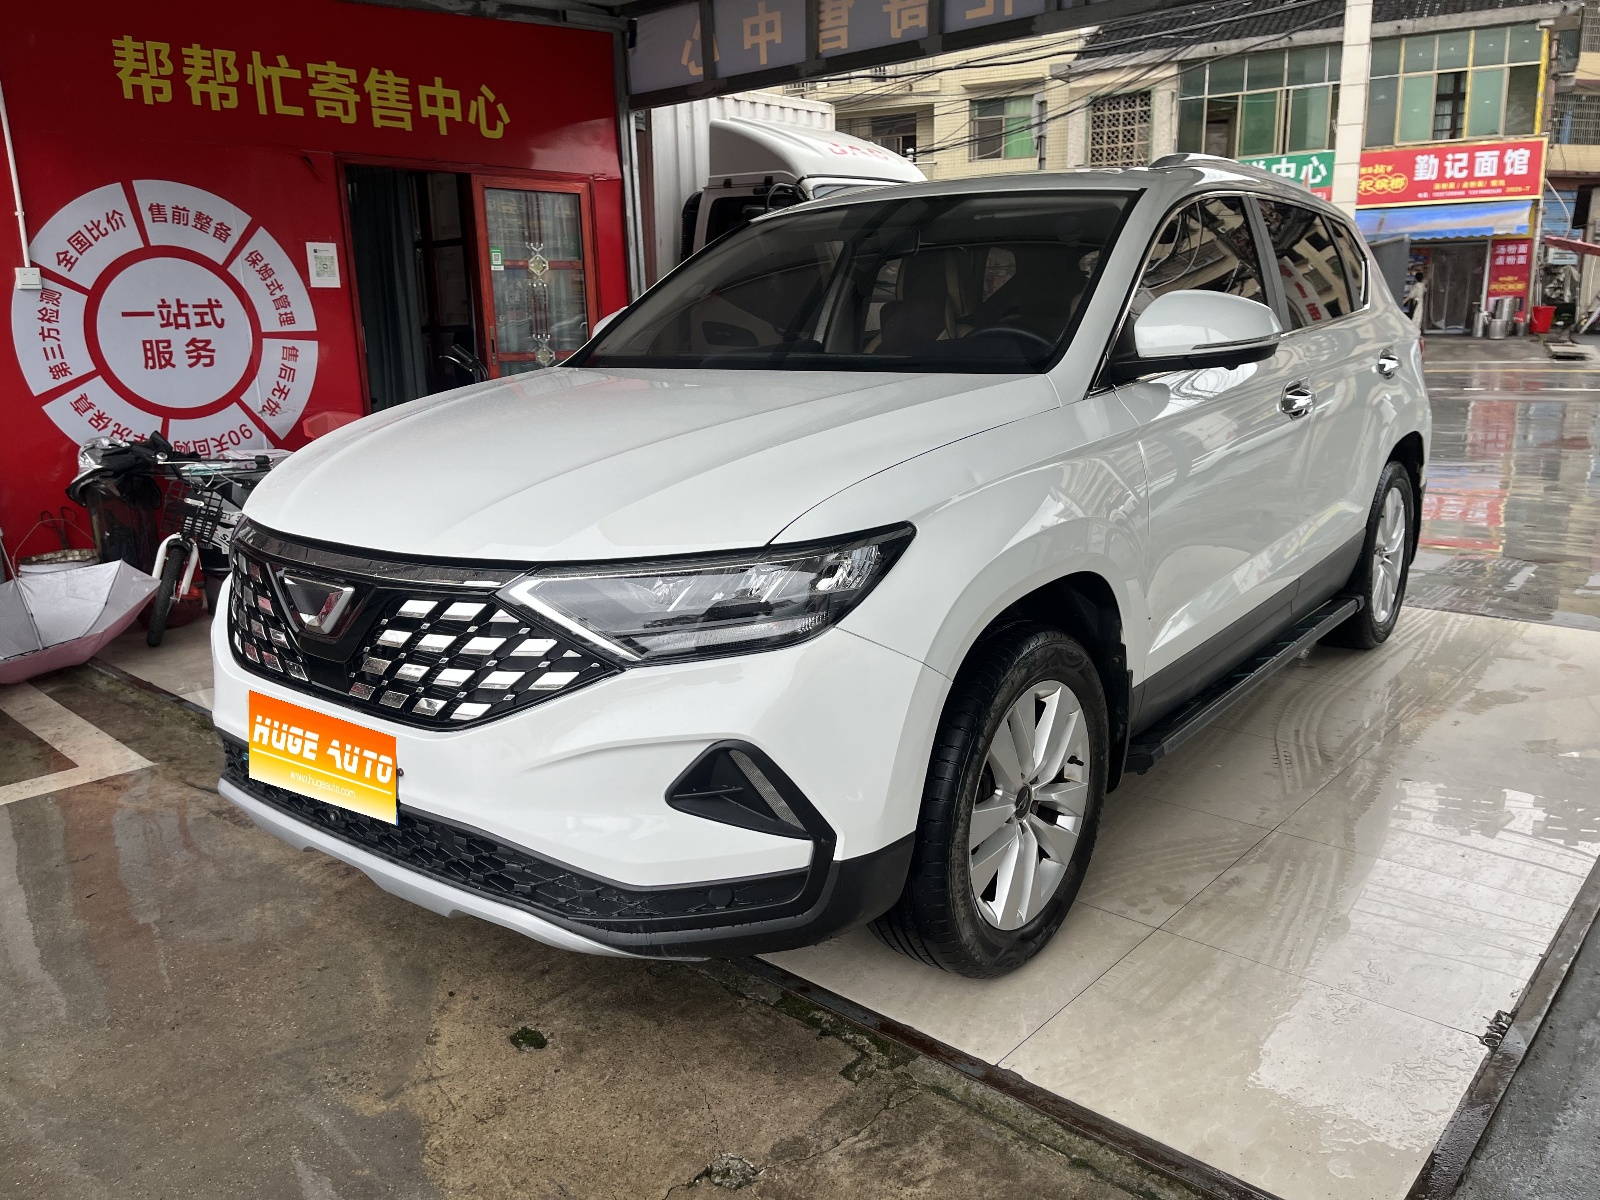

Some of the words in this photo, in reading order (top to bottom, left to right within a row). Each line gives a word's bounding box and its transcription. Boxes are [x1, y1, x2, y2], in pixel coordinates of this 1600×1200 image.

[112, 35, 511, 139] 帮帮忙寄售中心
[1413, 148, 1530, 180] 勤记面馆
[55, 209, 126, 272] 全国比价
[148, 203, 232, 243] 售前整备
[121, 298, 225, 330] 一站式
[244, 250, 296, 327] 保姆式管理
[37, 288, 73, 380] 第三方检测
[142, 337, 216, 370] 服务
[262, 345, 299, 417] 售后无忧
